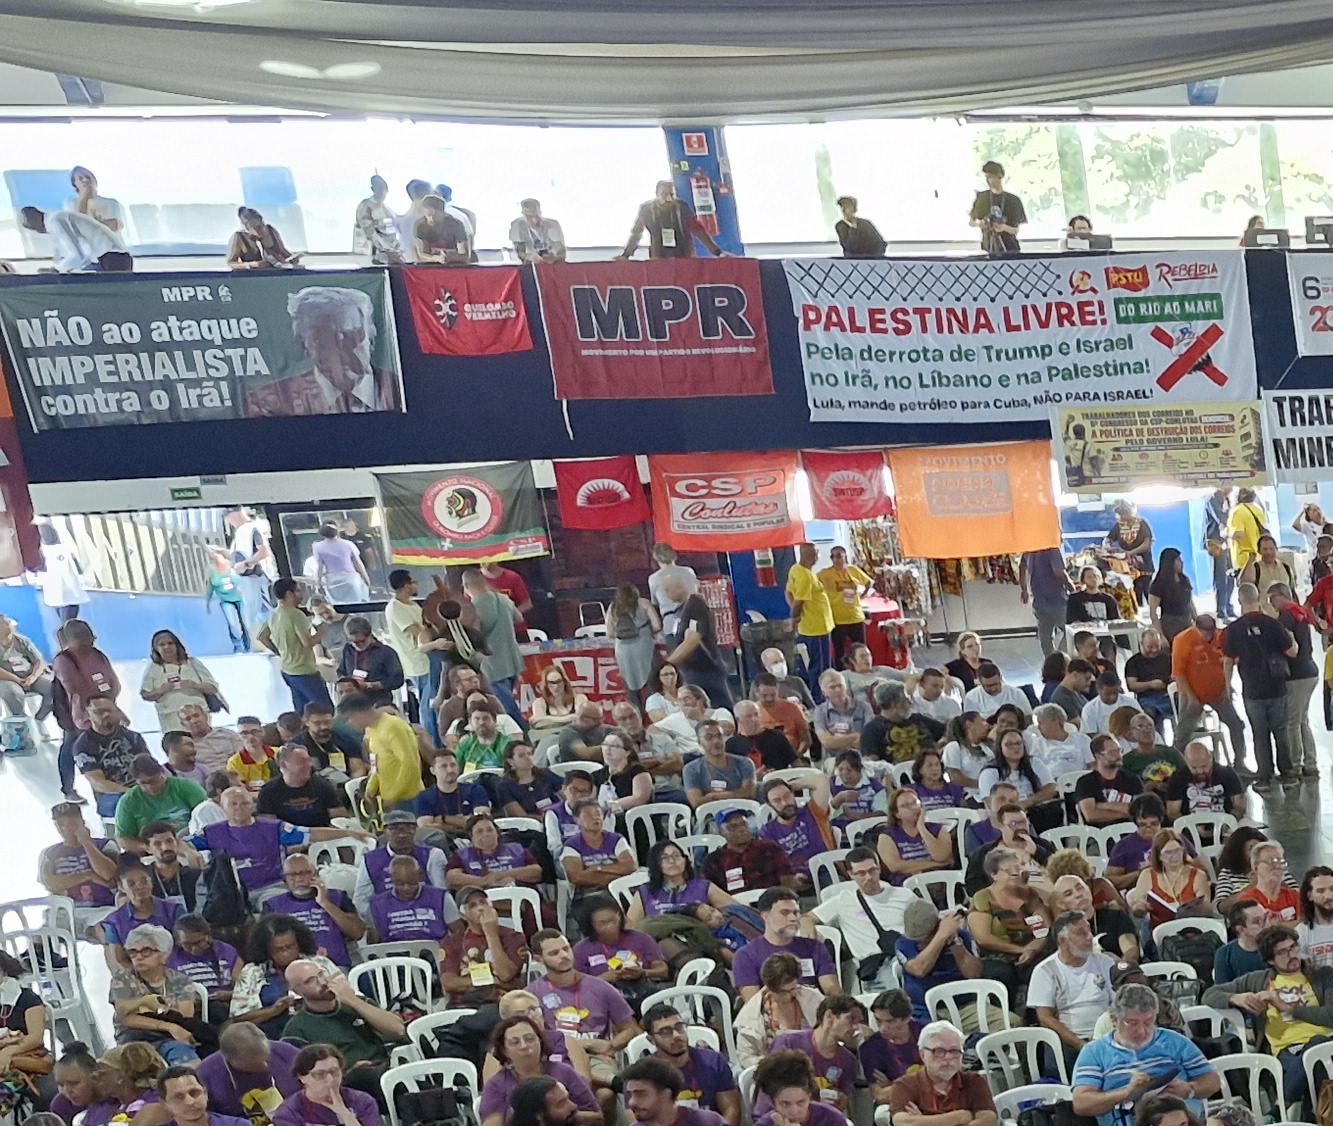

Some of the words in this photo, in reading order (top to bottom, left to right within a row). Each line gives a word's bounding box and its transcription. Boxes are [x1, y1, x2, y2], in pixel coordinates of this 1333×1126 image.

[161, 285, 214, 303] MPR
[1301, 275, 1322, 301] 6
[570, 284, 756, 341] MPR
[801, 303, 996, 337] PALESTINA
[1001, 300, 1108, 333] LIVRE!
[1118, 303, 1136, 317] DO
[1138, 301, 1161, 316] RIO
[1163, 300, 1181, 315] AO
[16, 309, 94, 349] NÃO
[101, 321, 142, 344] ao
[149, 315, 259, 346] ataque
[805, 341, 854, 361] Pela
[858, 343, 945, 364] derrota
[949, 344, 977, 363] de
[981, 338, 1053, 364] Trump
[1058, 341, 1071, 357] e
[1075, 333, 1134, 354] Israel
[26, 346, 271, 387] IMPERIALISTA
[809, 370, 840, 388] no
[843, 368, 880, 392] Irã,
[883, 372, 912, 391] no
[917, 368, 993, 390] Líbano
[997, 372, 1011, 389] e
[1016, 370, 1042, 387] na
[1046, 357, 1151, 383] Palestina!
[40, 387, 143, 417] contra
[149, 388, 170, 411] o
[175, 379, 234, 410] Irã!
[812, 396, 846, 411] Lula,
[847, 398, 896, 412] mande
[899, 397, 958, 414] petróleo
[960, 399, 991, 413] para
[992, 397, 1032, 411] Cuba,
[1033, 390, 1063, 406] NÃO
[1065, 390, 1101, 403] PARA
[1103, 387, 1154, 401] ISRAEL!
[674, 475, 777, 497] CSP
[680, 501, 779, 521] Conlutas
